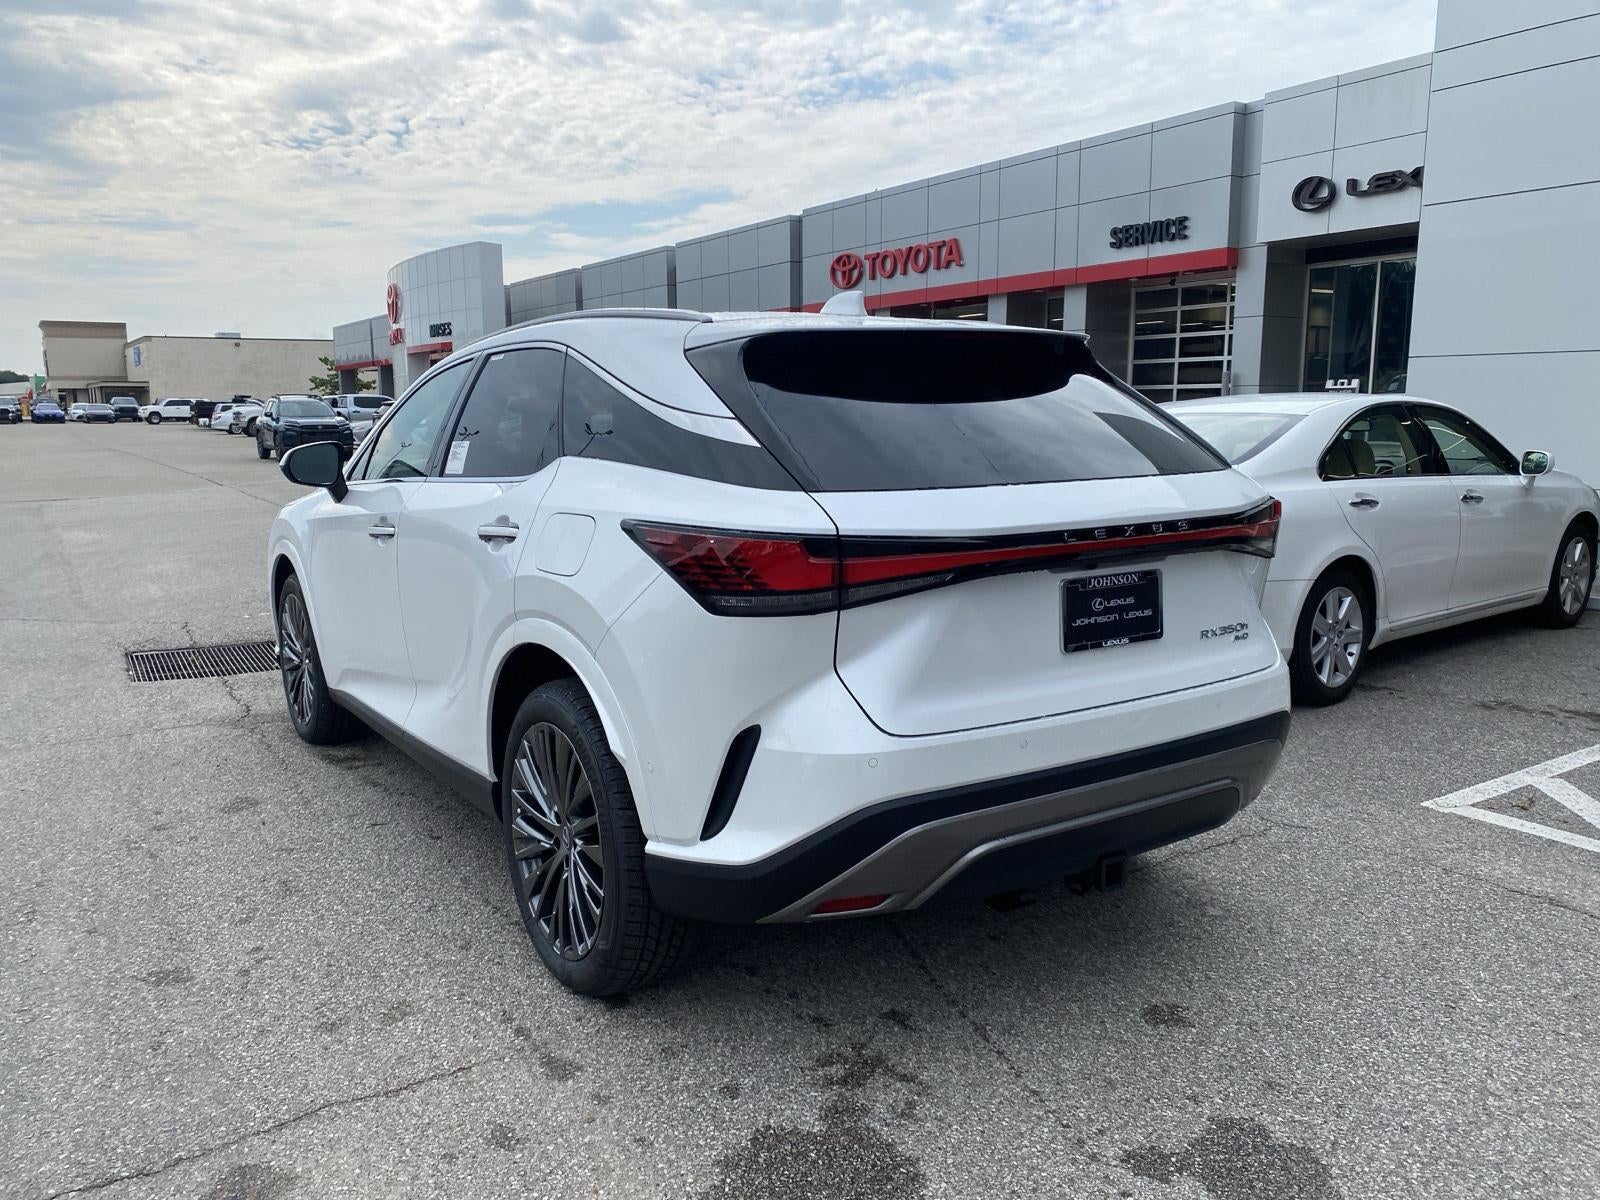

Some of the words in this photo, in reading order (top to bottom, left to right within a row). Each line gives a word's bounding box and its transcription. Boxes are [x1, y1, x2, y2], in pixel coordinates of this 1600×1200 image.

[1109, 216, 1189, 249] SERVICE
[864, 238, 964, 281] TOYOTA
[1064, 520, 1189, 541] LEXUS
[1088, 573, 1139, 588] JOHNSON
[1105, 597, 1135, 607] LEXUS
[1072, 613, 1119, 627] JOHNSON
[1123, 609, 1153, 619] LEXUS
[1102, 638, 1130, 647] LEXUS
